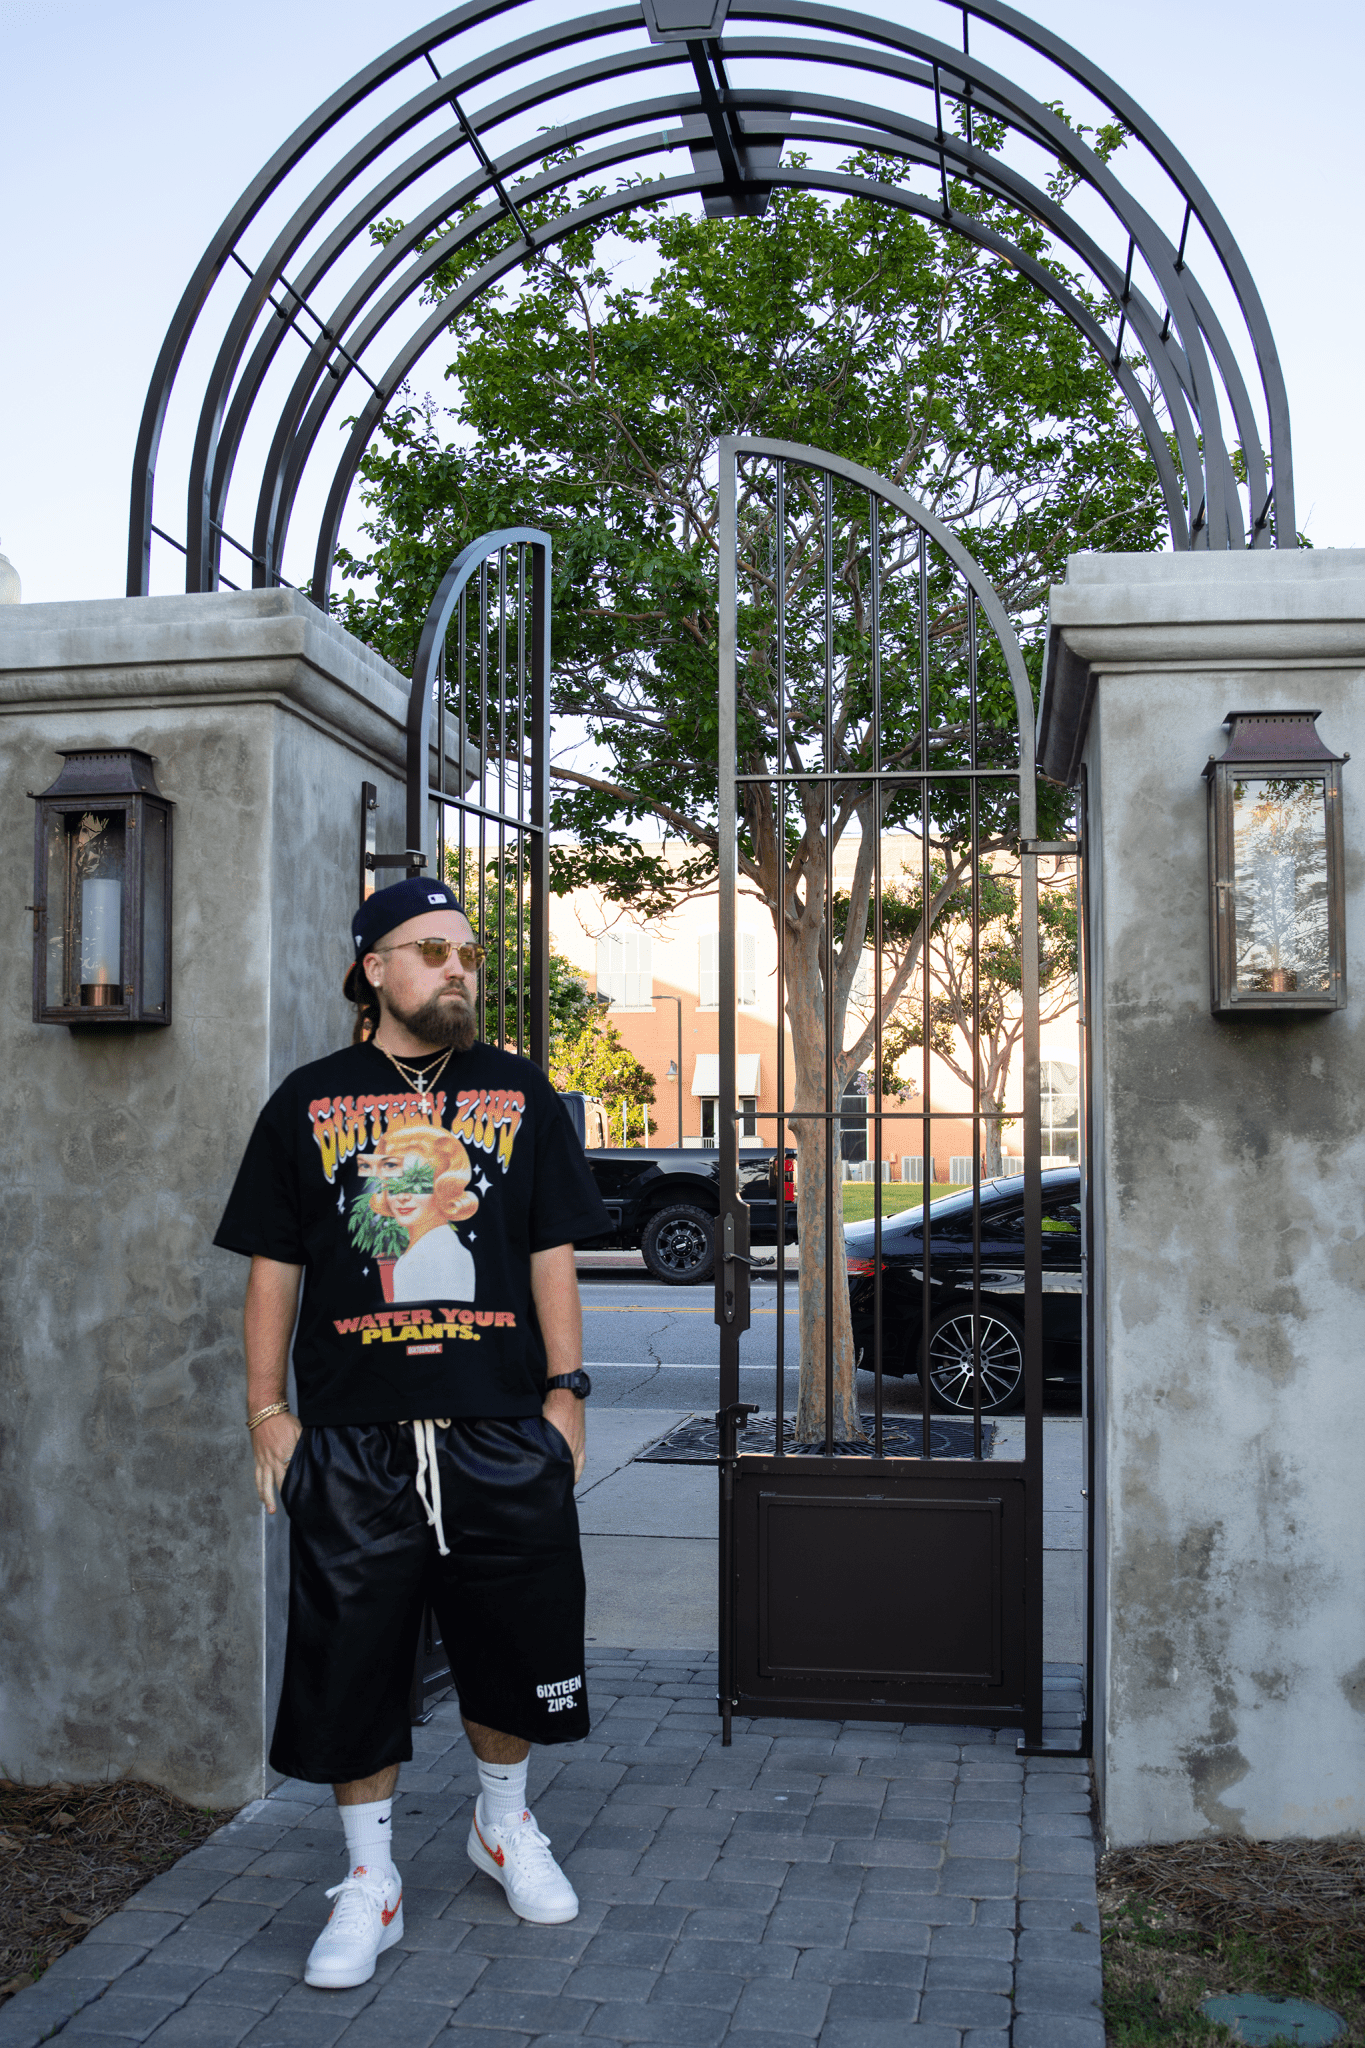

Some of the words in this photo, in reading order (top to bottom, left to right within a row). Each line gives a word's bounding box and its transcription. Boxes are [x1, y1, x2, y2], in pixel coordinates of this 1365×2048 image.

[451, 1089, 526, 1174] ZIPS
[333, 1309, 434, 1335] WATER
[438, 1308, 516, 1327] YOUR
[361, 1323, 481, 1345] PLANTS.
[536, 1675, 581, 1698] 6IXTEEN
[547, 1695, 577, 1712] ZIPS.
